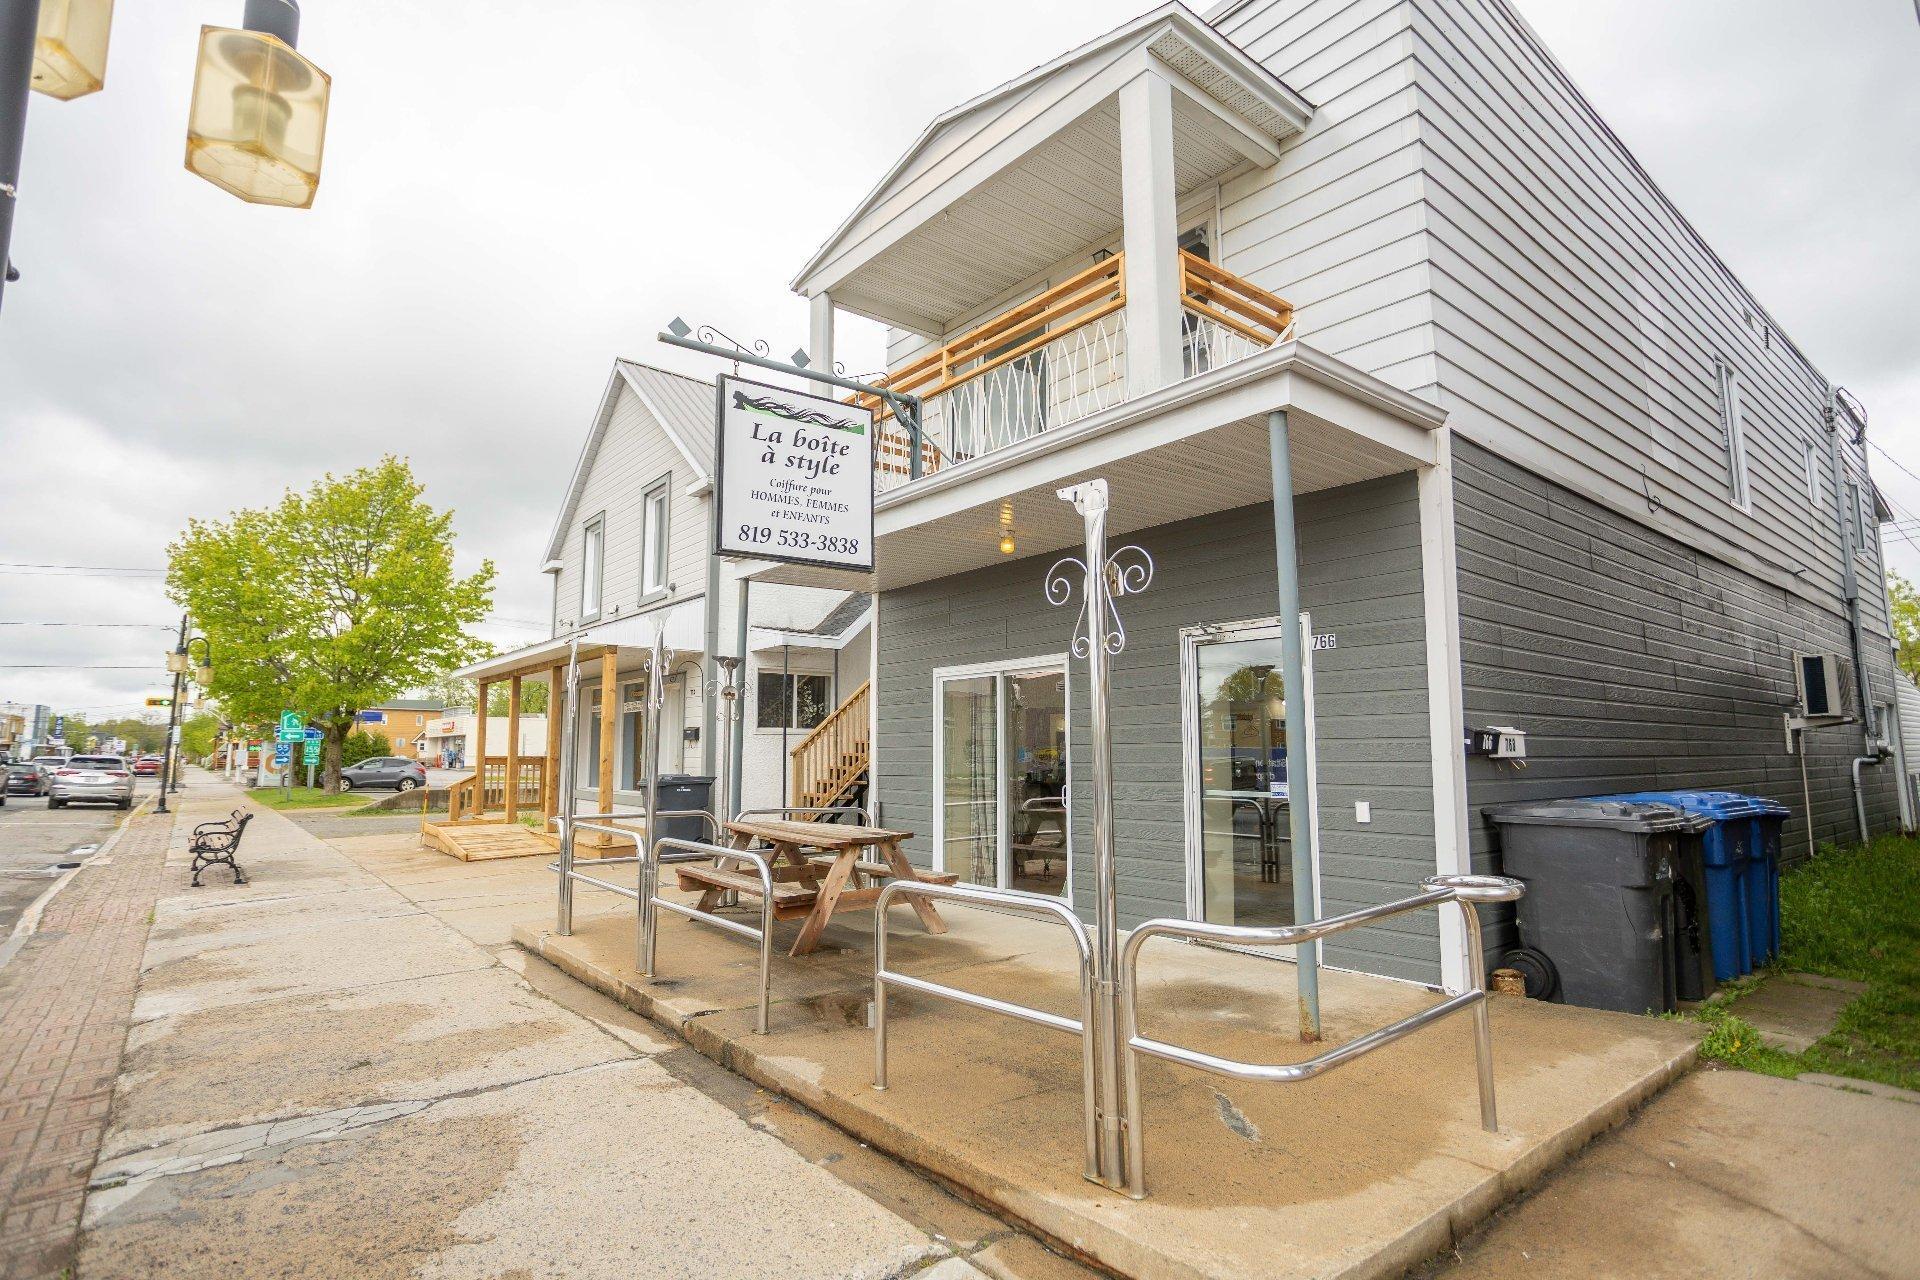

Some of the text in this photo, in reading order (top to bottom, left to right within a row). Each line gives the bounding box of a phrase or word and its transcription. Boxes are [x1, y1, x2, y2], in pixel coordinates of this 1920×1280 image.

[750, 422, 850, 457] La boîte
[761, 445, 840, 480] à style
[769, 478, 833, 496] Coiffure pour
[750, 490, 849, 513] HOMMES, FEMMES
[771, 509, 830, 525] et ENFANTS
[738, 524, 859, 555] 819 533-3838
[1312, 634, 1335, 648] 766
